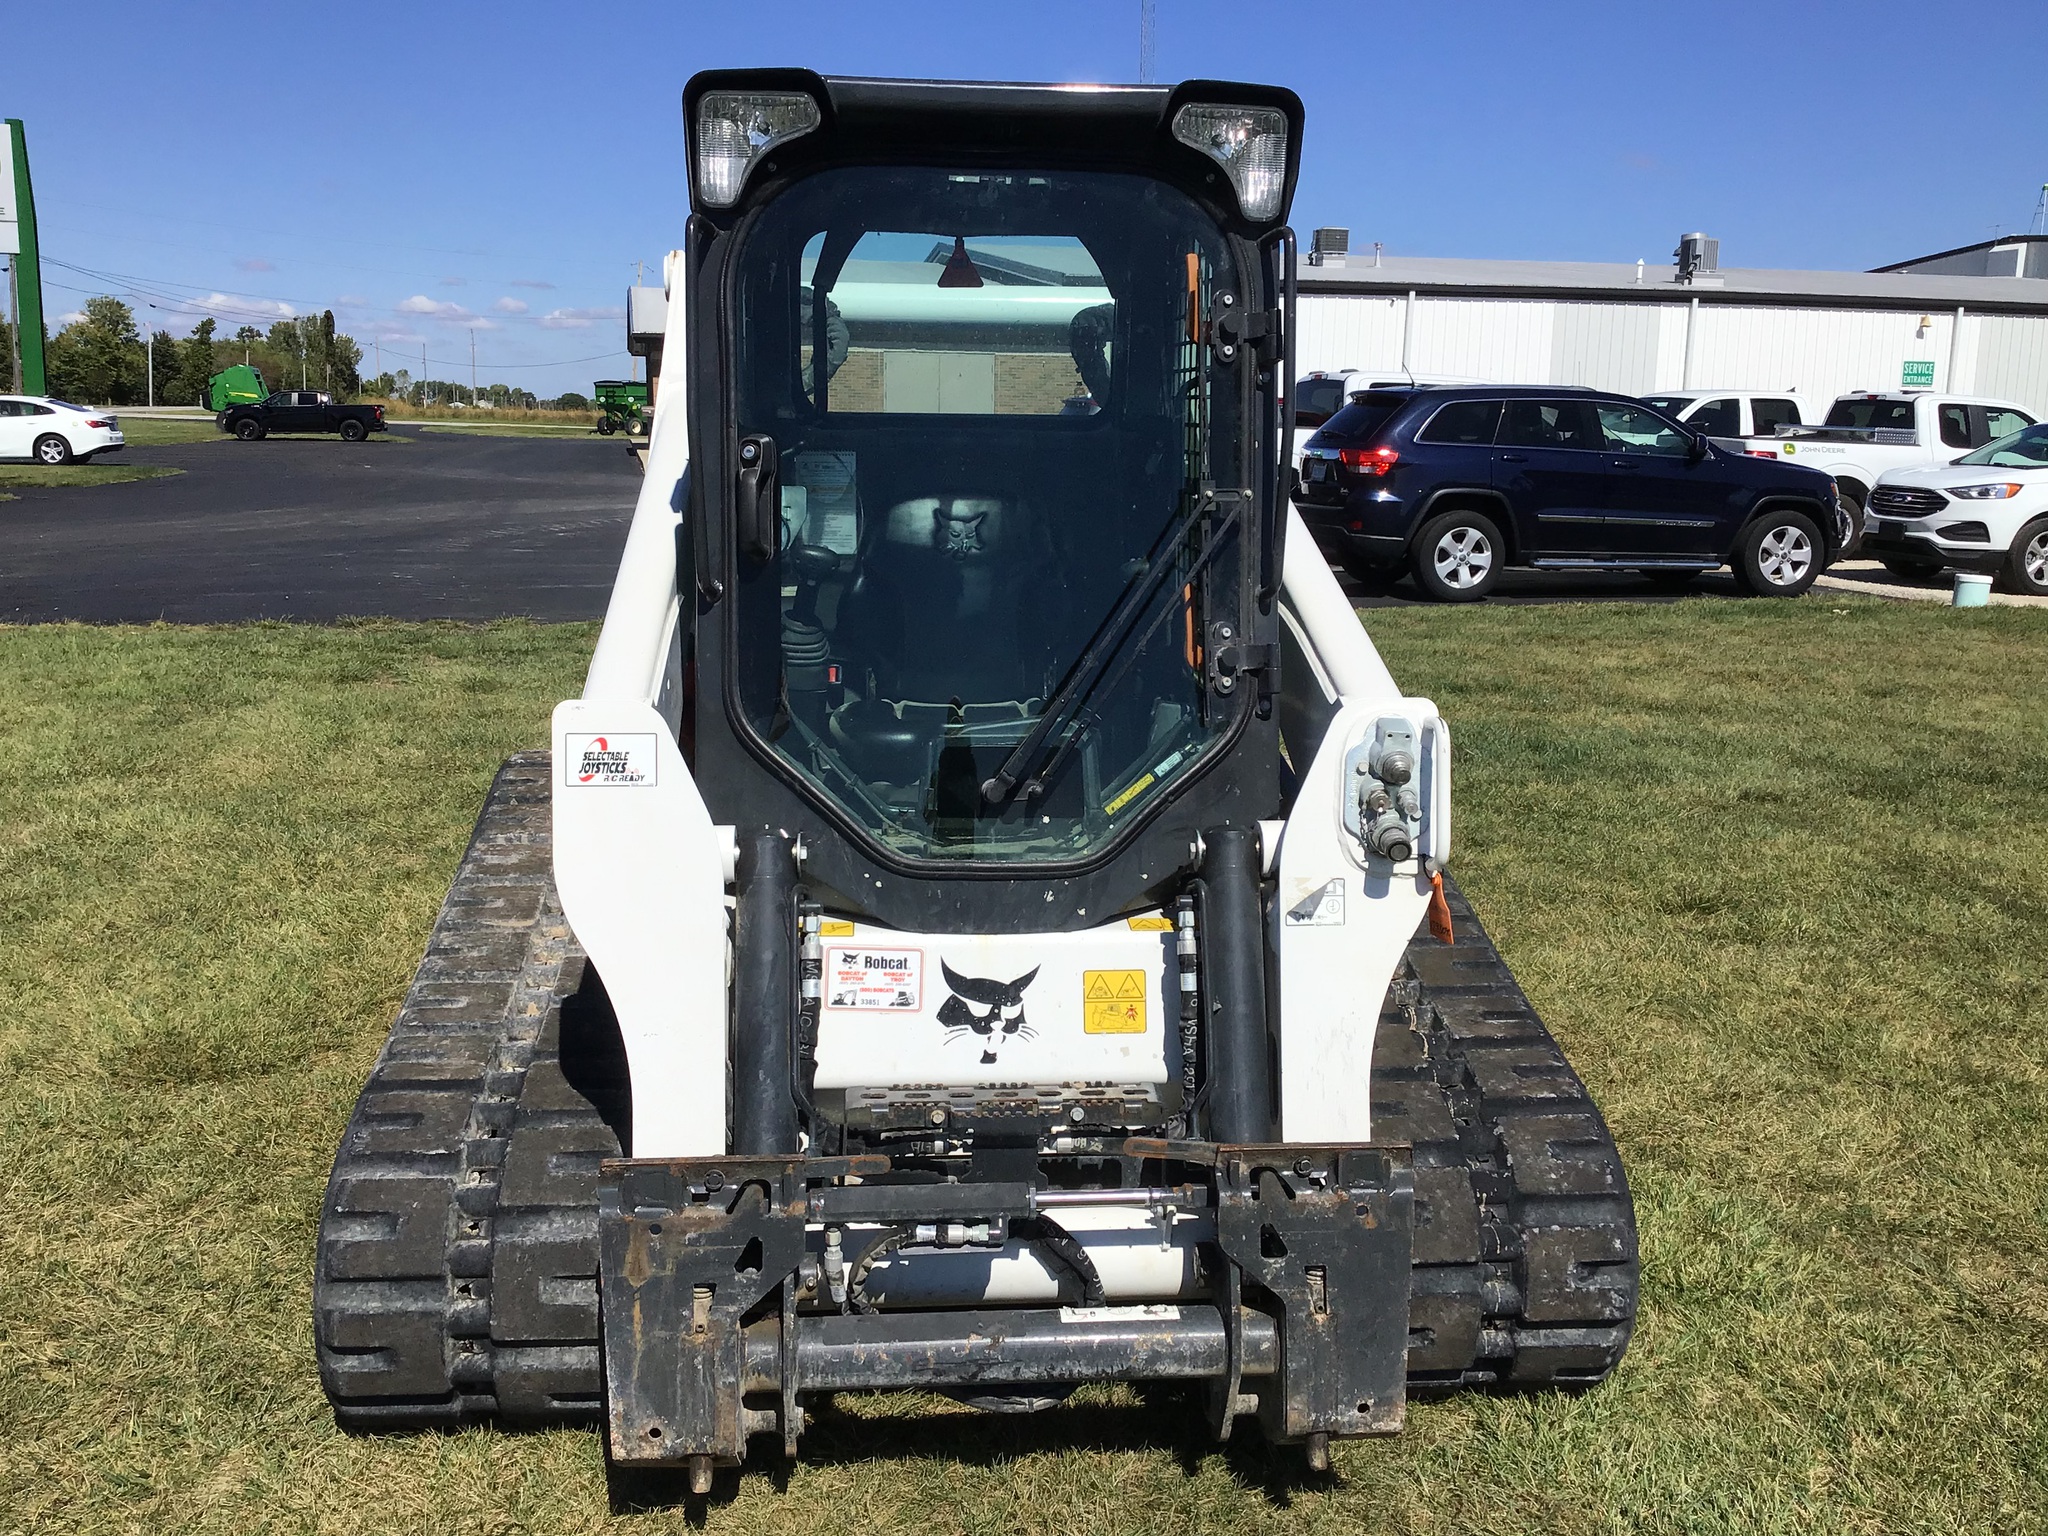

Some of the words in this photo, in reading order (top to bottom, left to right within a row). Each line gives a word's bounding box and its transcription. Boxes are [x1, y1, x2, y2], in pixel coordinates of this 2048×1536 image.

[1904, 363, 1934, 374] SERVICE
[1903, 375, 1932, 384] ENTRANCE
[1821, 446, 1846, 454] DEERE
[582, 751, 630, 761] SELECTABLE
[578, 762, 628, 774] JOYSTICKS
[619, 774, 646, 782] READY
[864, 955, 908, 970] Bobcat
